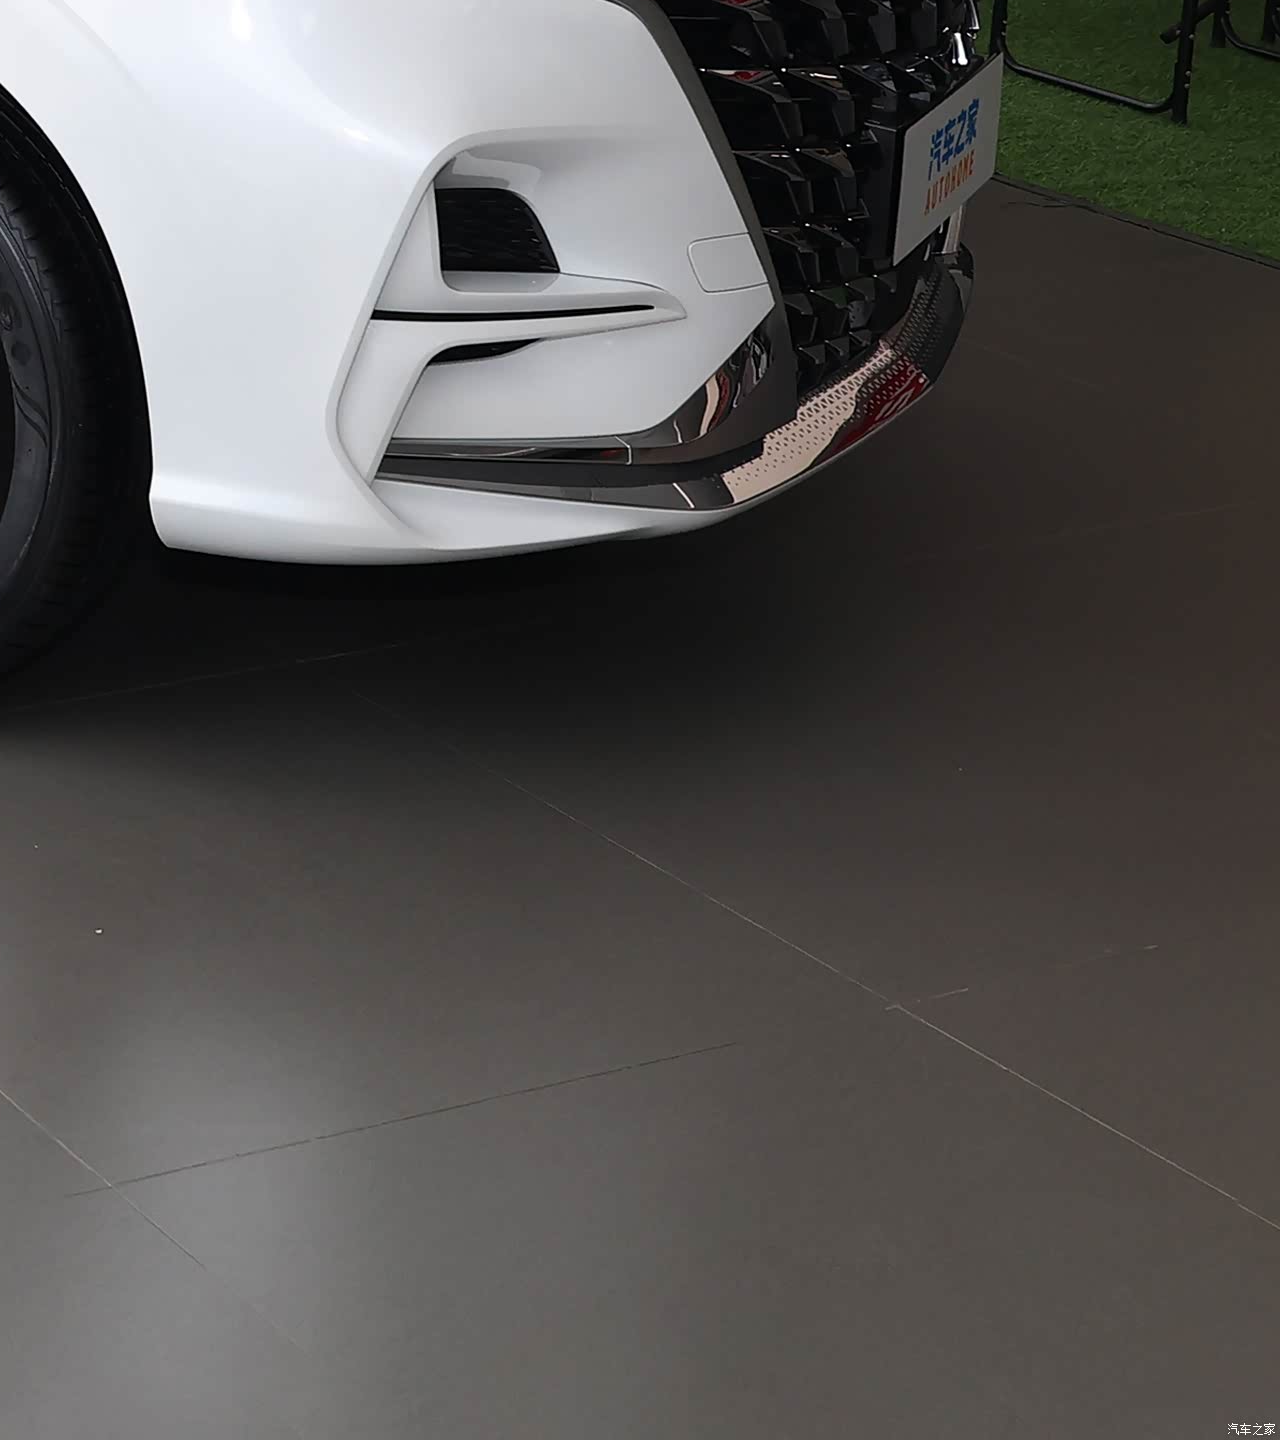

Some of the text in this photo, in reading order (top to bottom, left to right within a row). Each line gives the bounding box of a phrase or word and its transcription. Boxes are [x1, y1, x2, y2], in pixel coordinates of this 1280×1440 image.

[928, 98, 980, 181] 汽车之家
[924, 149, 976, 217] AUTOHOME
